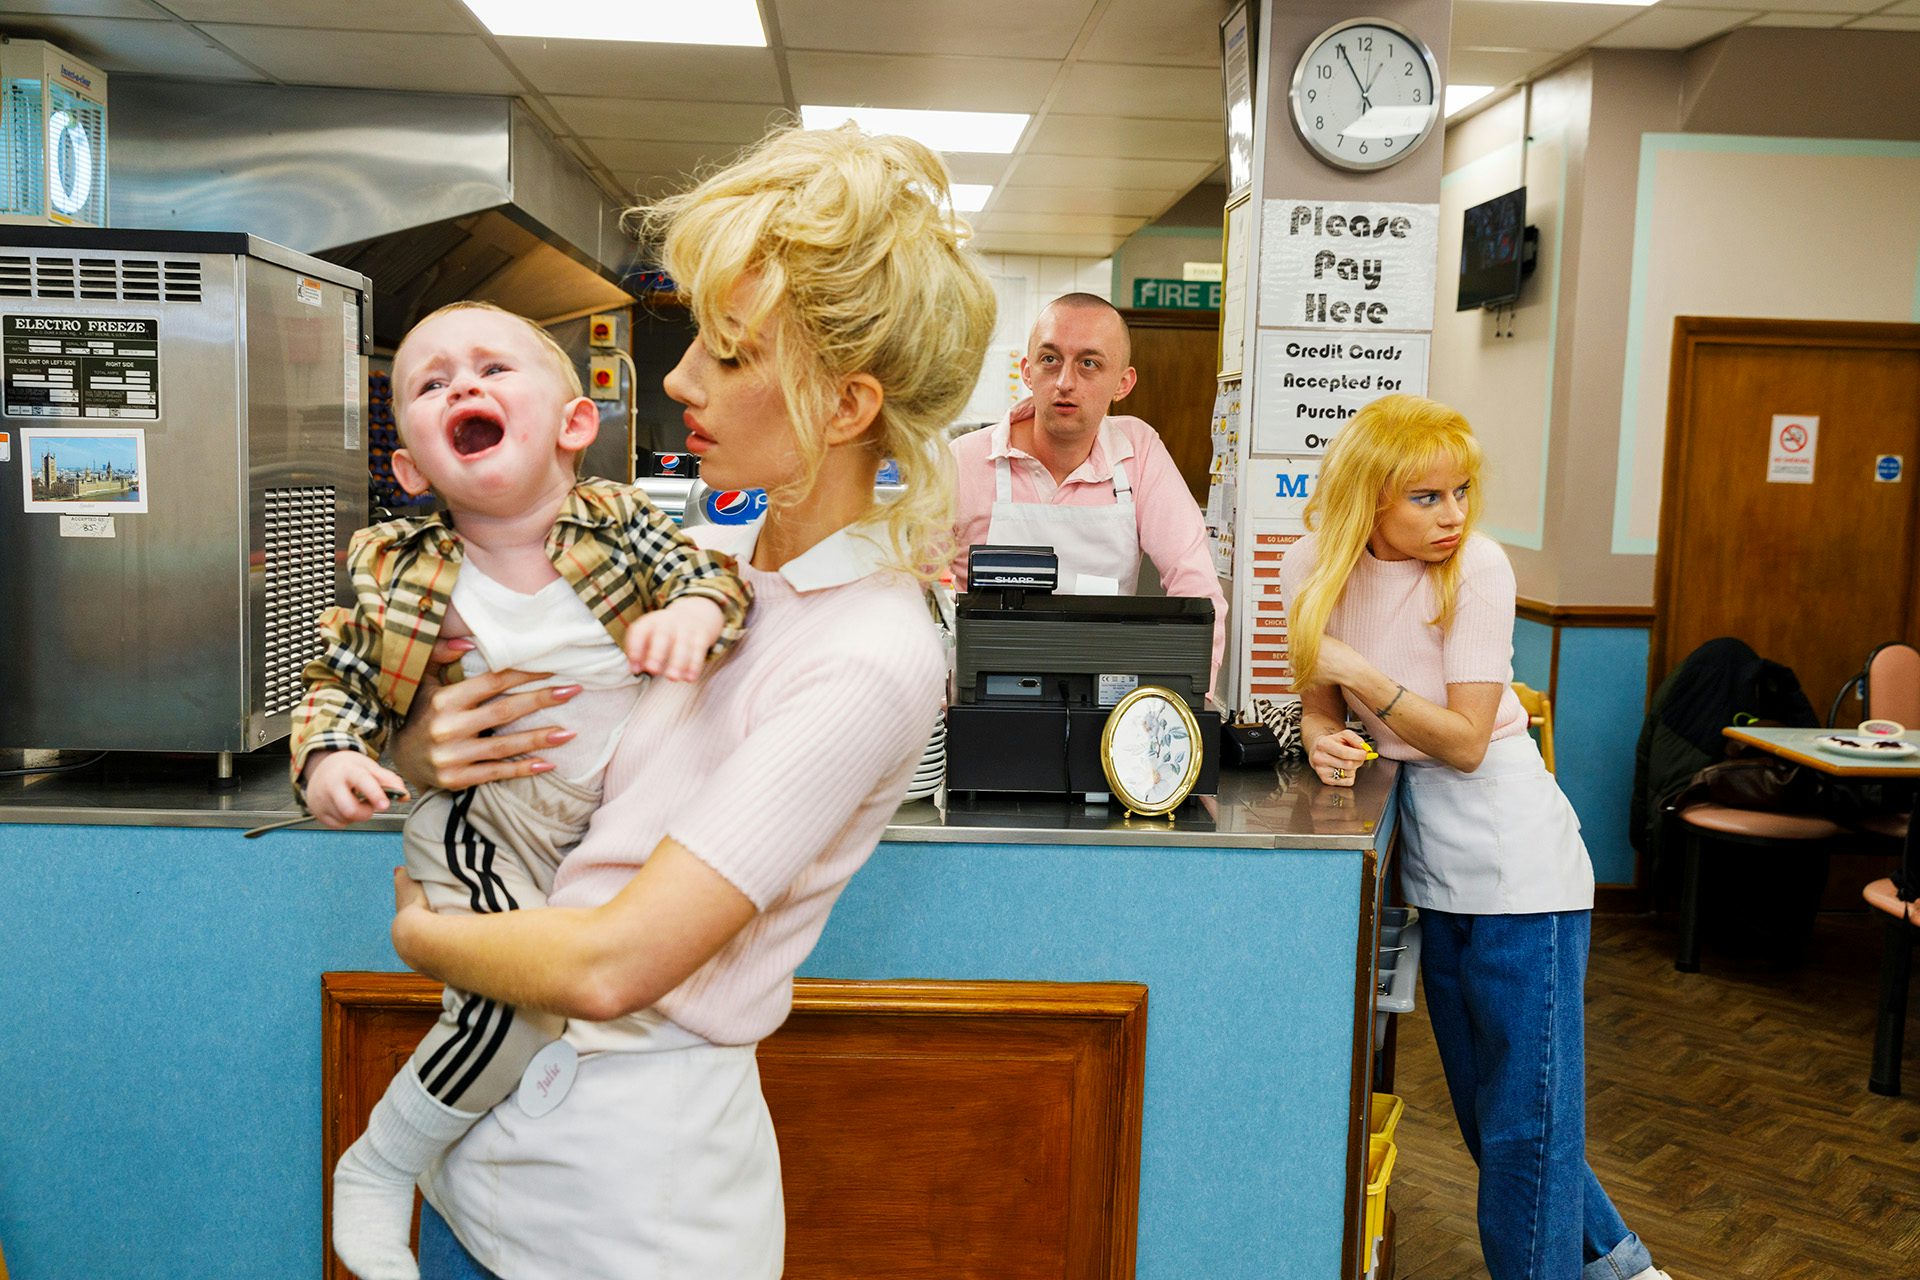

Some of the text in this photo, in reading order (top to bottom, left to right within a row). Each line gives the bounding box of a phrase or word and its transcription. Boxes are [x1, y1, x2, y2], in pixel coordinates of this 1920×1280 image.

[1357, 37, 1373, 51] 12
[1387, 44, 1393, 58] 1
[1335, 45, 1347, 59] 11
[1316, 65, 1332, 79] 10
[1404, 62, 1413, 76] 2
[1307, 89, 1317, 103] 9
[1412, 89, 1421, 103] 3
[1315, 116, 1324, 130] 8
[1337, 134, 1345, 148] 7
[1359, 140, 1368, 154] 6
[1289, 205, 1412, 239] Please
[1314, 249, 1382, 290] Pay
[1141, 281, 1201, 307] FIRE
[1305, 293, 1389, 324] Here
[15, 318, 146, 333] ELECTRO FREEZE
[1285, 342, 1403, 361] Credit Cards
[1283, 372, 1402, 392] Accepted for
[1305, 433, 1333, 449] Ov
[994, 576, 1034, 584] SHARP
